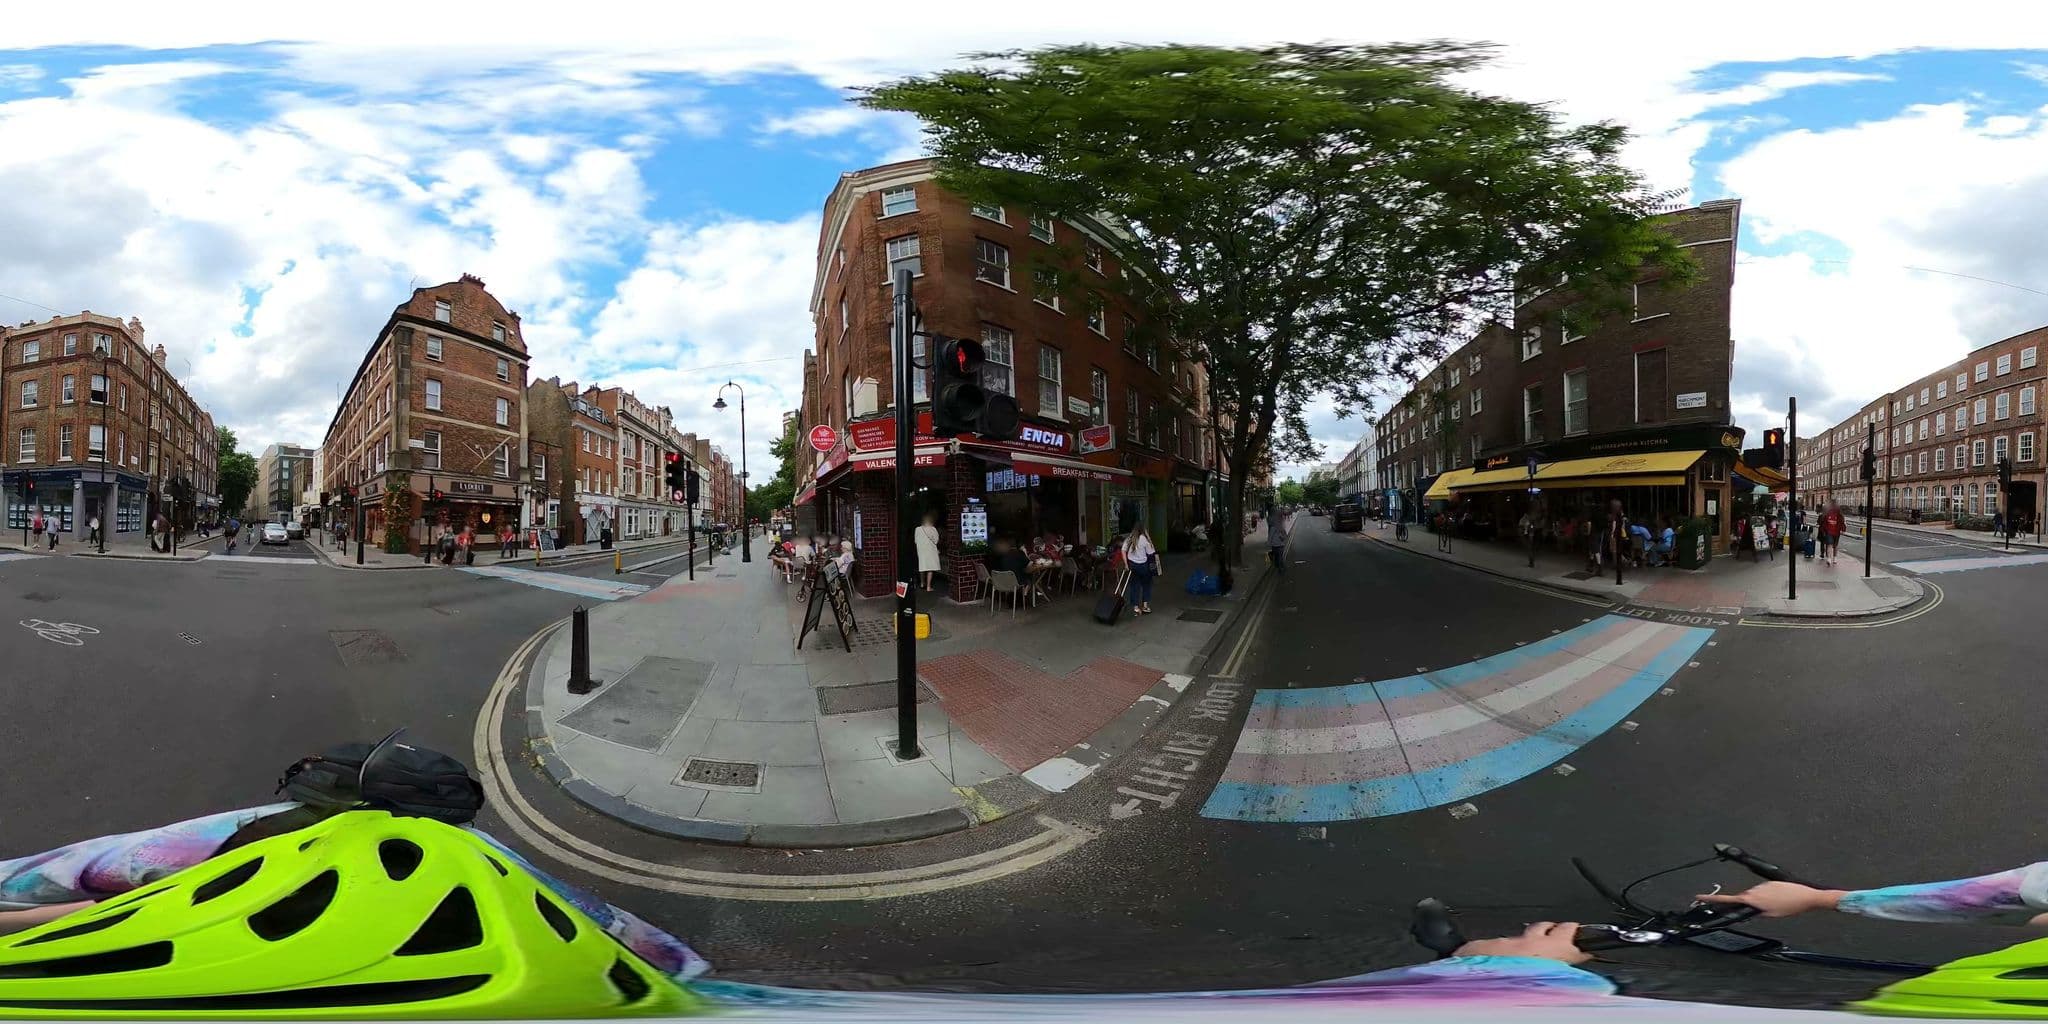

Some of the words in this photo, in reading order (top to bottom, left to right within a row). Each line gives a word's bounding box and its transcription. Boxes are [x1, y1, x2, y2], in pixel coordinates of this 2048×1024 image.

[1640, 438, 1669, 447] KITCHEN
[914, 456, 933, 465] AFE
[1052, 466, 1089, 478] BREAKFAST
[1611, 606, 1656, 619] LEFT
[1666, 613, 1712, 625] LOOK
[1188, 681, 1245, 722] LOOK
[1116, 731, 1219, 809] RIGHT
